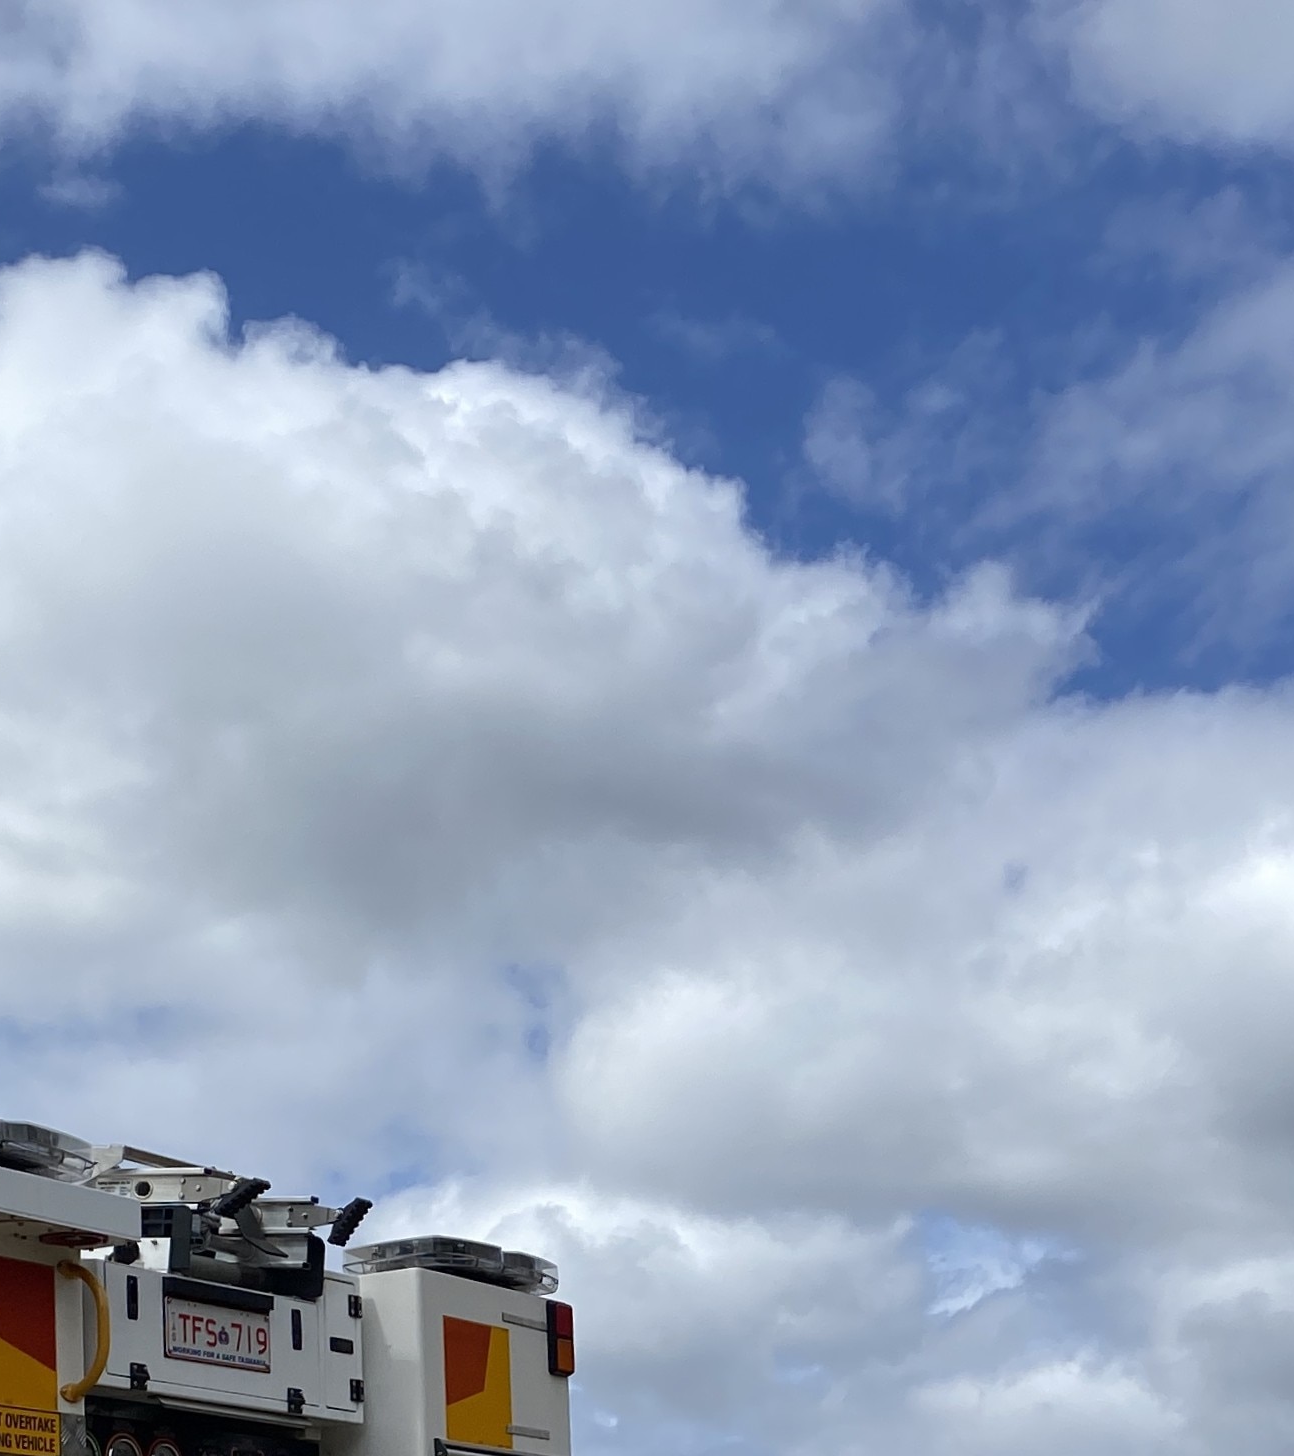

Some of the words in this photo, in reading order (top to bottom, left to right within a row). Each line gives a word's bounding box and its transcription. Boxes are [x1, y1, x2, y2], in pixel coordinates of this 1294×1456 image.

[178, 1313, 217, 1348] TFS
[230, 1323, 267, 1356] 719
[5, 1413, 57, 1434] OVERTAKE
[14, 1434, 56, 1453] VEHICLE
